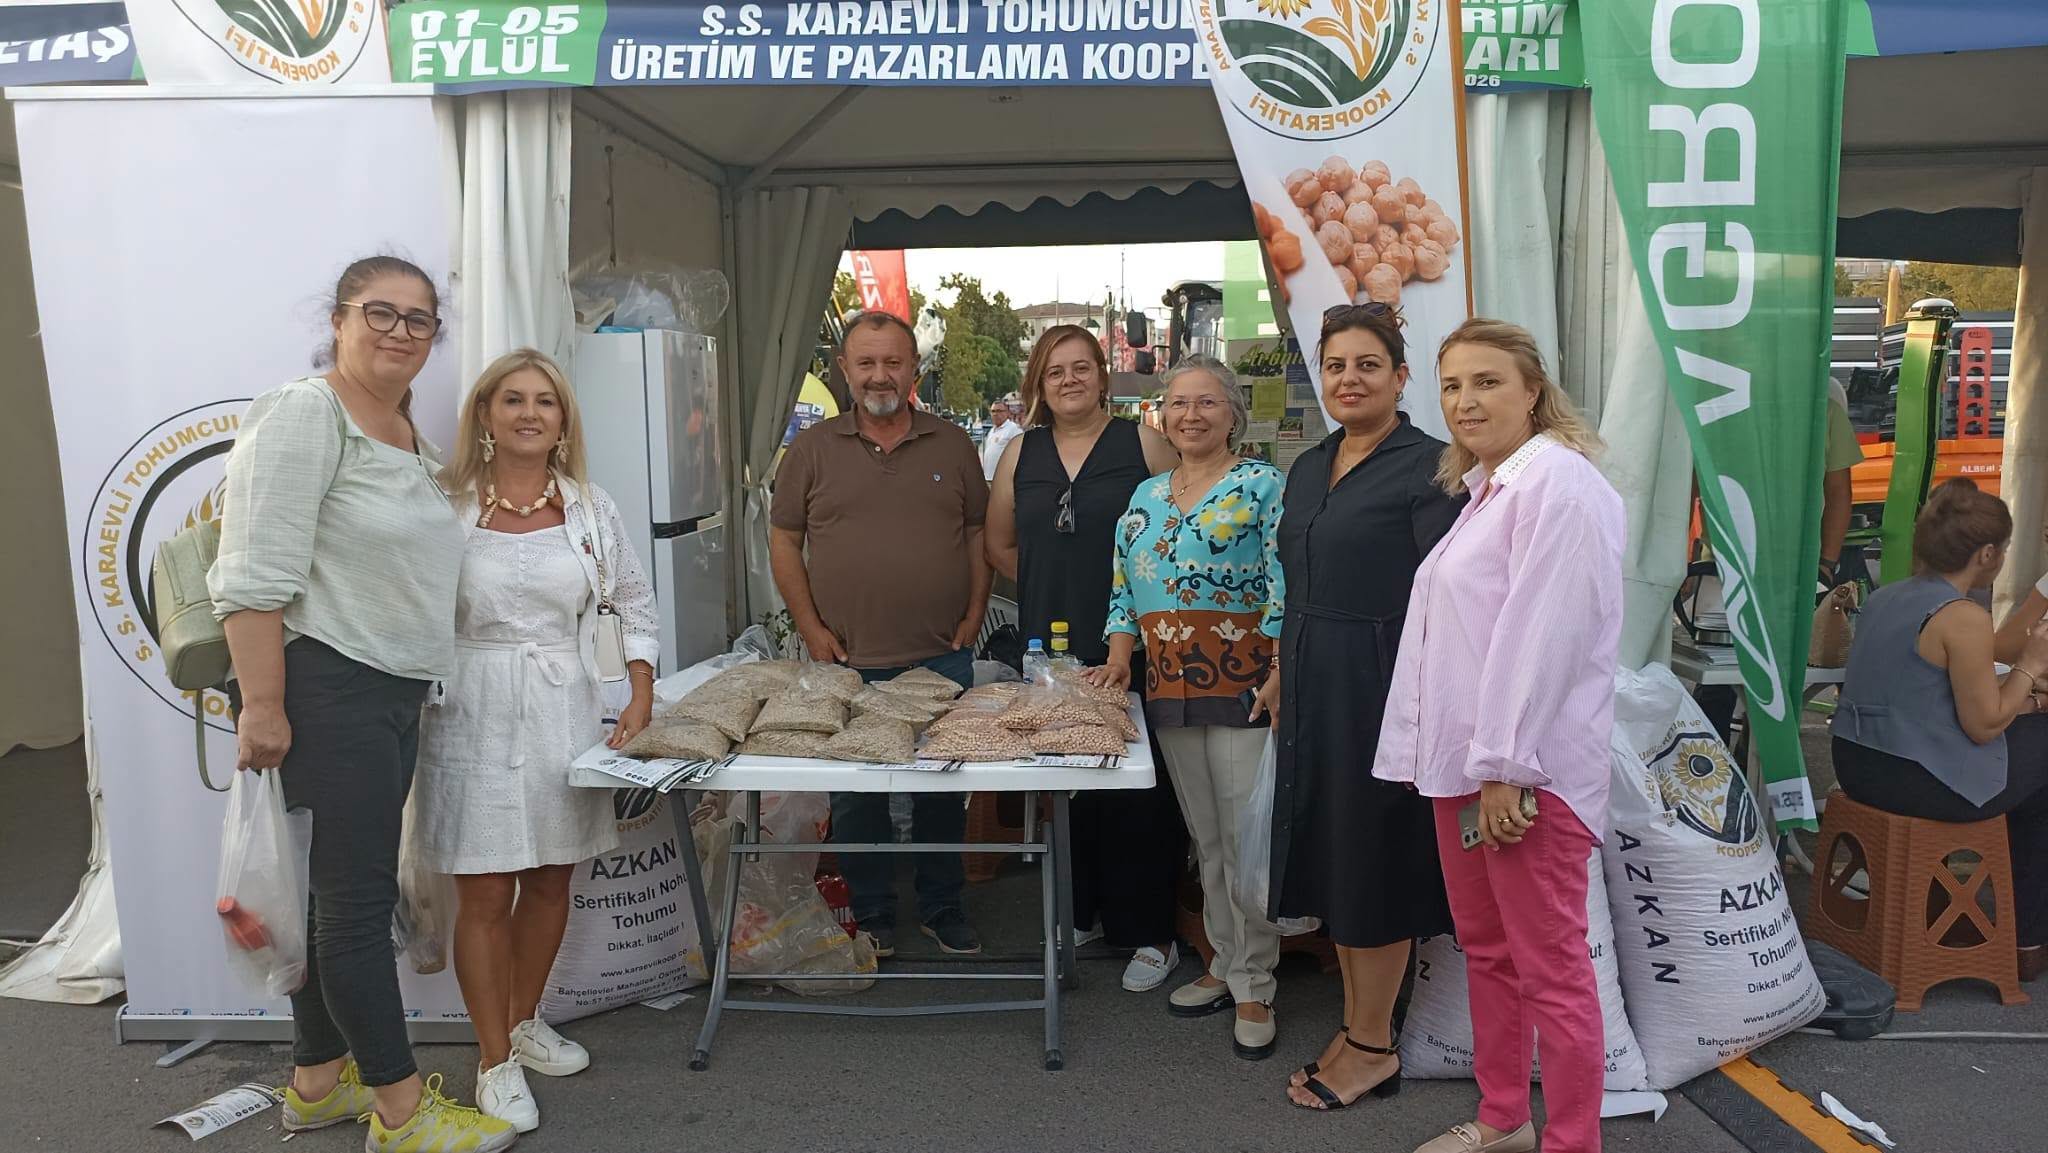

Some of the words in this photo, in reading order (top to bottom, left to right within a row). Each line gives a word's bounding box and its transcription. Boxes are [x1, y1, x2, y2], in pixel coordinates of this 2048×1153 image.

[700, 4, 772, 36] S.S.
[411, 36, 570, 80] EYLÜL
[610, 39, 756, 80] ÜRETİM
[769, 45, 816, 79] VE
[827, 43, 1069, 80] PAZARLAMA
[1464, 36, 1560, 71] ARI
[98, 488, 133, 608] KARAEVLİ
[590, 838, 677, 880] AZKAN
[573, 886, 656, 909] Sertifikalı
[1615, 829, 1680, 984] AZKAN
[612, 902, 677, 929] Tohumu
[1703, 918, 1782, 946] Sertifikalı
[1748, 935, 1798, 968] Tohumu
